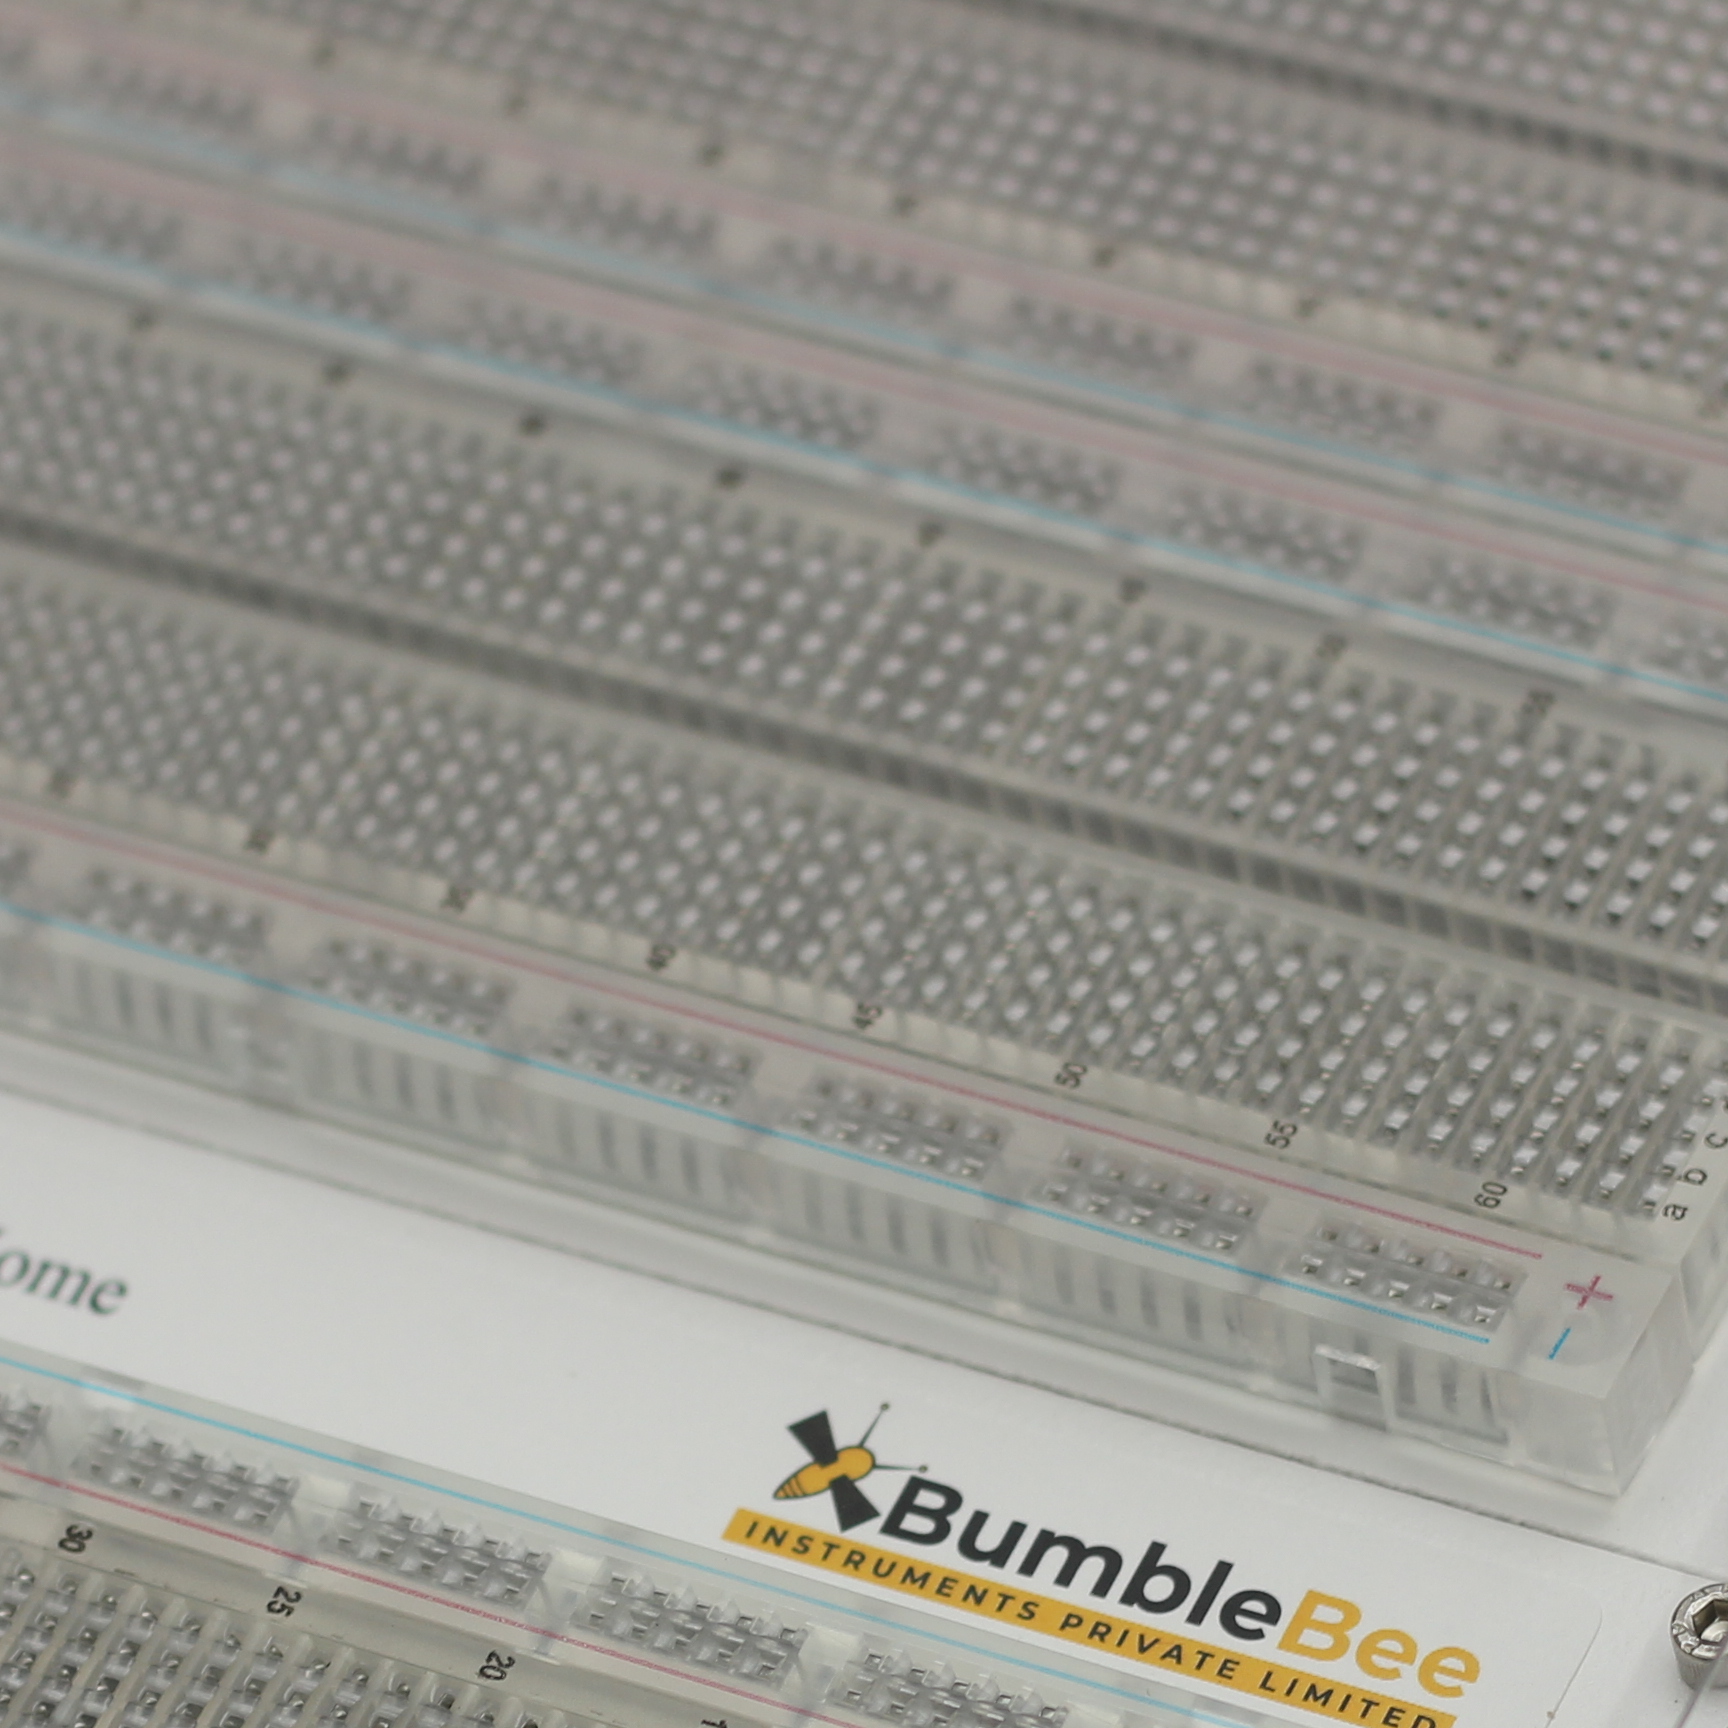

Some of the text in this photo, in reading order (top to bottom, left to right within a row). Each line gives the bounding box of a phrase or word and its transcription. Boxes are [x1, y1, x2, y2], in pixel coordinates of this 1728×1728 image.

[1263, 1119, 1298, 1150] 55
[1474, 1180, 1509, 1210] 60
[1679, 1166, 1709, 1188] b
[1705, 1131, 1728, 1151] c
[1661, 1201, 1689, 1222] a
[57, 1522, 94, 1556] 30
[265, 1585, 303, 1620] 25
[478, 1648, 517, 1683] 20
[742, 1517, 1042, 1624] INSTRUMENTS
[1058, 1610, 1239, 1683] PRIVATE
[878, 1473, 1483, 1700] BumbleBee
